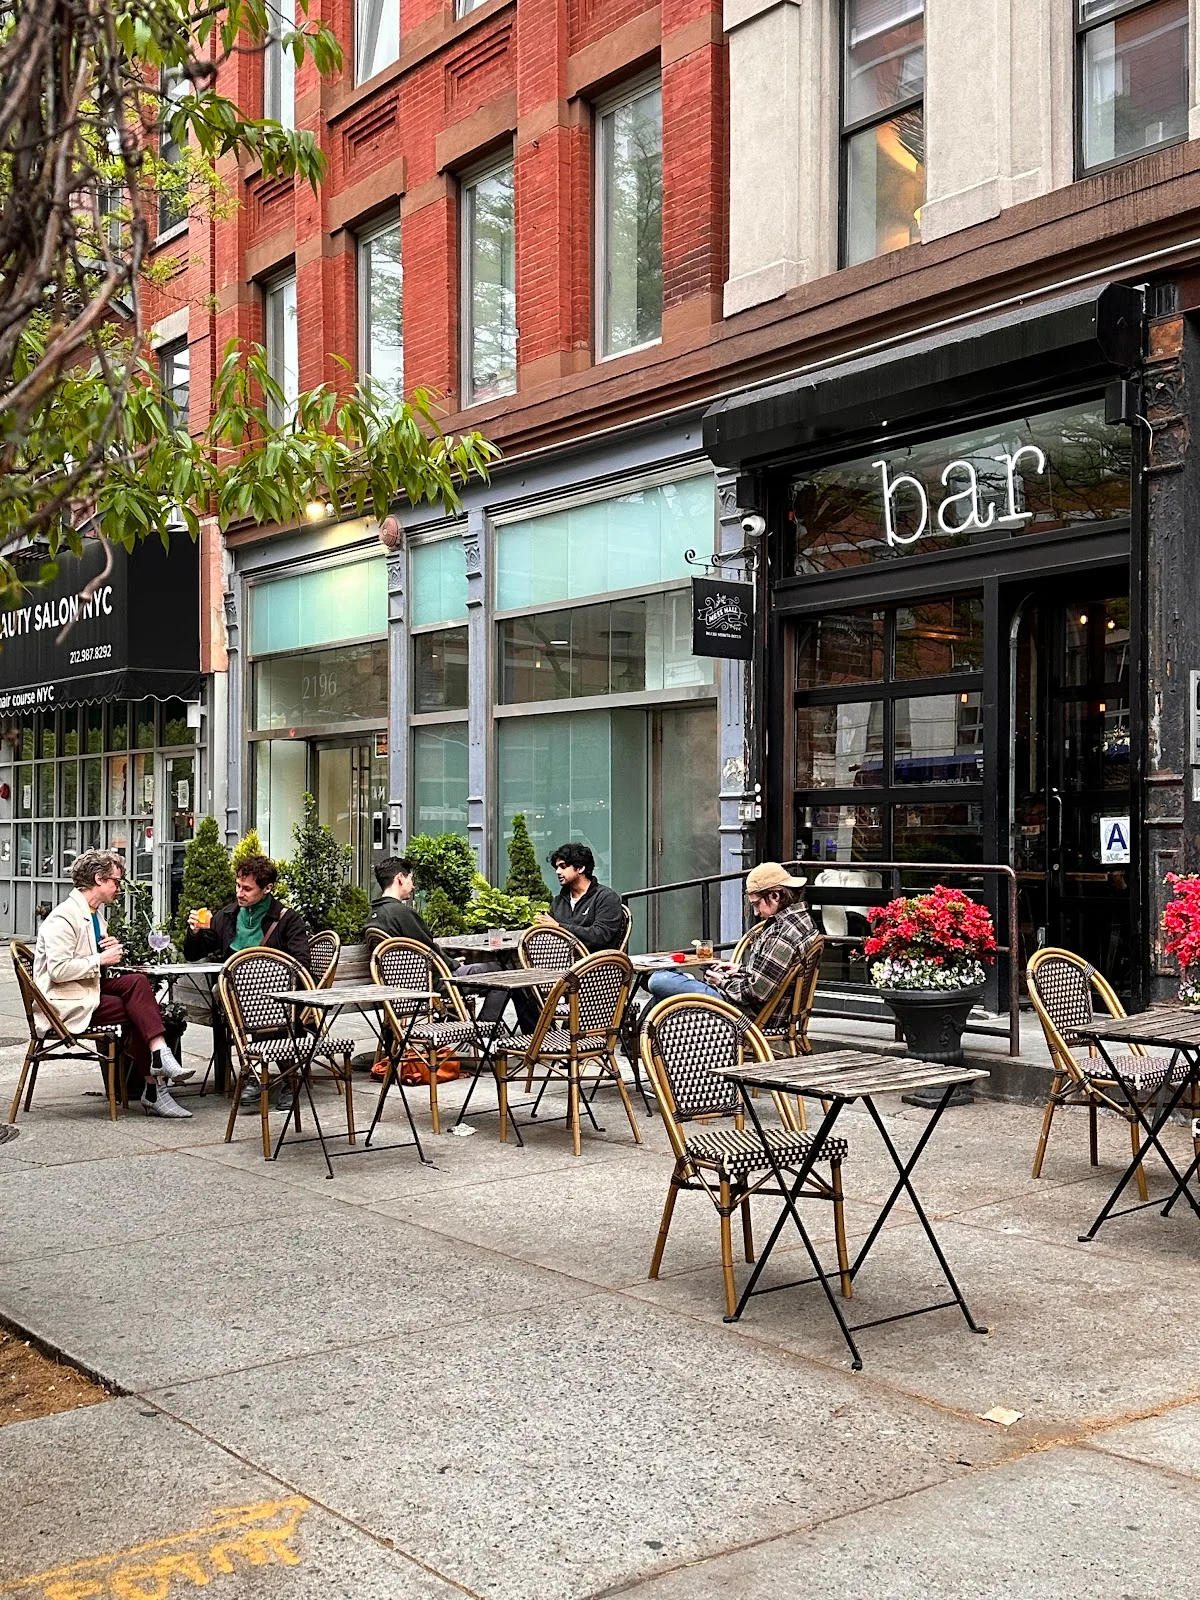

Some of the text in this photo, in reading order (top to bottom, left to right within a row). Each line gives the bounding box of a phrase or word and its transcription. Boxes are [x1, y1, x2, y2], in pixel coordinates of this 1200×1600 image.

[871, 445, 1045, 547] bar
[34, 594, 79, 631] SALON
[83, 585, 113, 620] NYC
[69, 644, 112, 664] 212.987.8292
[12, 691, 36, 707] course
[36, 685, 55, 703] NYC
[302, 671, 337, 700] 2196
[1106, 823, 1128, 850] A
